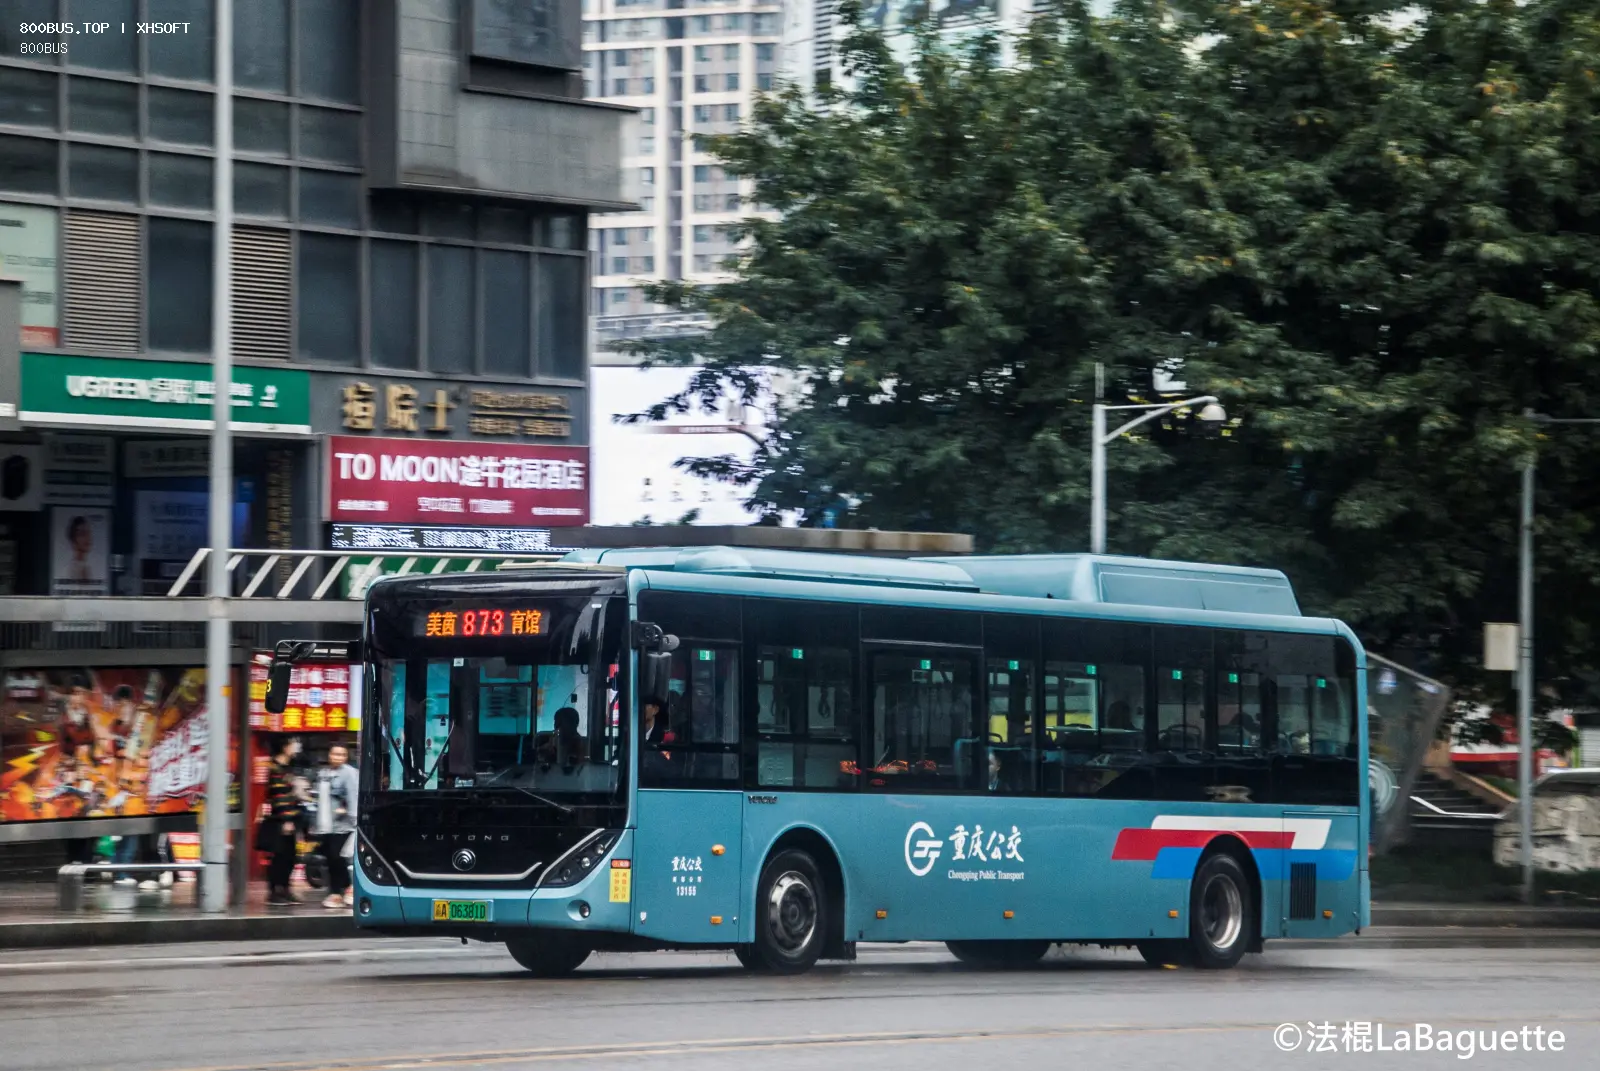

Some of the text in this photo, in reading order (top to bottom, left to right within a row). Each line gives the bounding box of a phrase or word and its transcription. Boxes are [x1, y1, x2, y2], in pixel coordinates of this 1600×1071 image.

[334, 452, 376, 480] TO
[380, 454, 460, 483] MOON
[462, 609, 505, 636] 873
[510, 609, 541, 635] 育馆
[421, 833, 510, 842] YUTONG
[948, 824, 1024, 862] 重庆公交
[671, 855, 703, 872] 重庆公交
[948, 870, 1024, 881] Chongqing Public Transport
